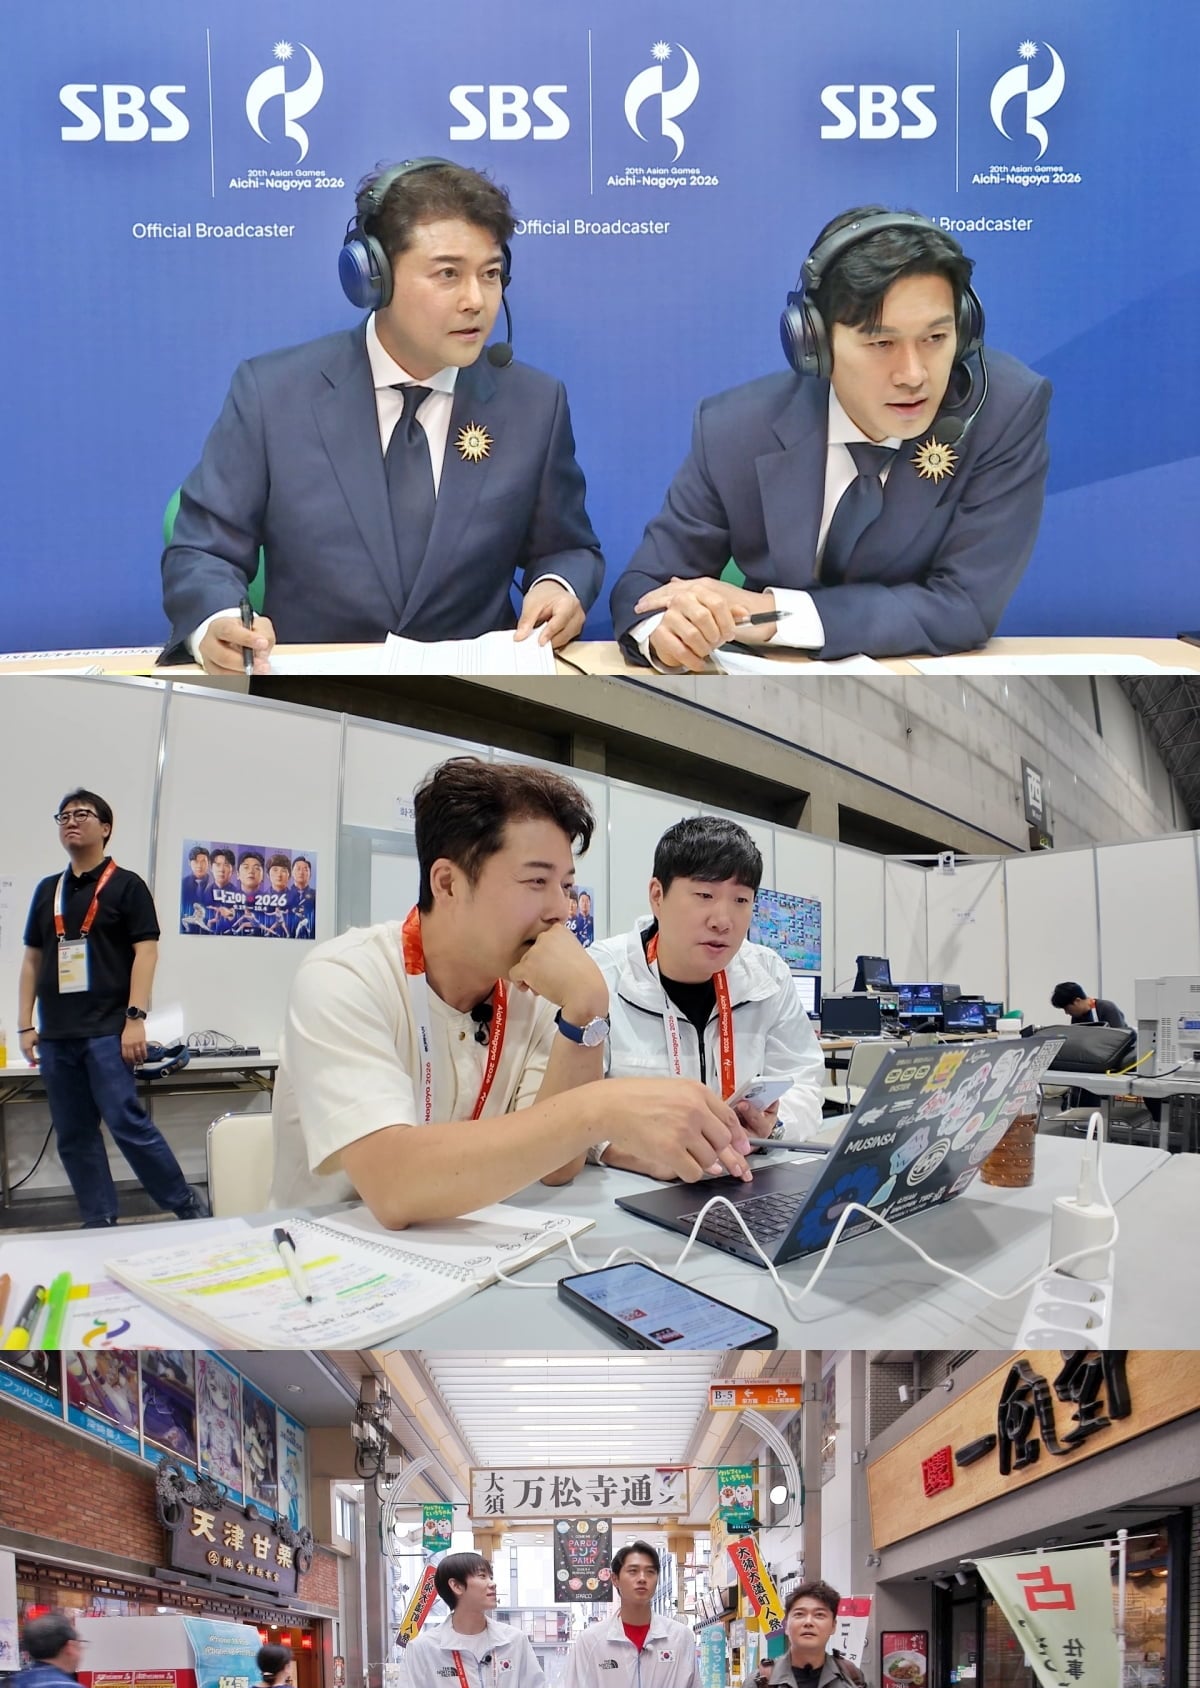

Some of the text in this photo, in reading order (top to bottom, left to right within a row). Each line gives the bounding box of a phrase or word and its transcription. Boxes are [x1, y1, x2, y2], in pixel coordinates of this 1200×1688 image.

[59, 84, 190, 142] SBS
[449, 84, 570, 141] SBS
[820, 84, 937, 140] SBS
[247, 169, 326, 177] 20th Asian Games
[625, 167, 700, 175] 20th Asian Games
[989, 165, 1063, 173] 20th Asian Games
[229, 177, 345, 191] Aichi-Nagoya 2026
[607, 175, 719, 188] Aichi-Nagoya 2026
[971, 173, 1081, 186] Aichi-Nagoya 2026
[132, 221, 295, 239] Official Broadcaster
[514, 219, 670, 235] Official Broadcaster
[939, 216, 1033, 232] Broadcaster
[1026, 767, 1042, 812] 西
[213, 889, 287, 906] 나고야 2026
[668, 1015, 676, 1031] 2026
[491, 1004, 504, 1060] Aichi-Nagoya
[486, 1062, 495, 1085] 2026
[844, 1132, 897, 1154] MUSINSA
[715, 1391, 733, 1400] B-5
[484, 1472, 675, 1515] 大須 万松寺通
[190, 1507, 293, 1568] 天津甘栗
[738, 1547, 783, 1632] 大須大道町人祭
